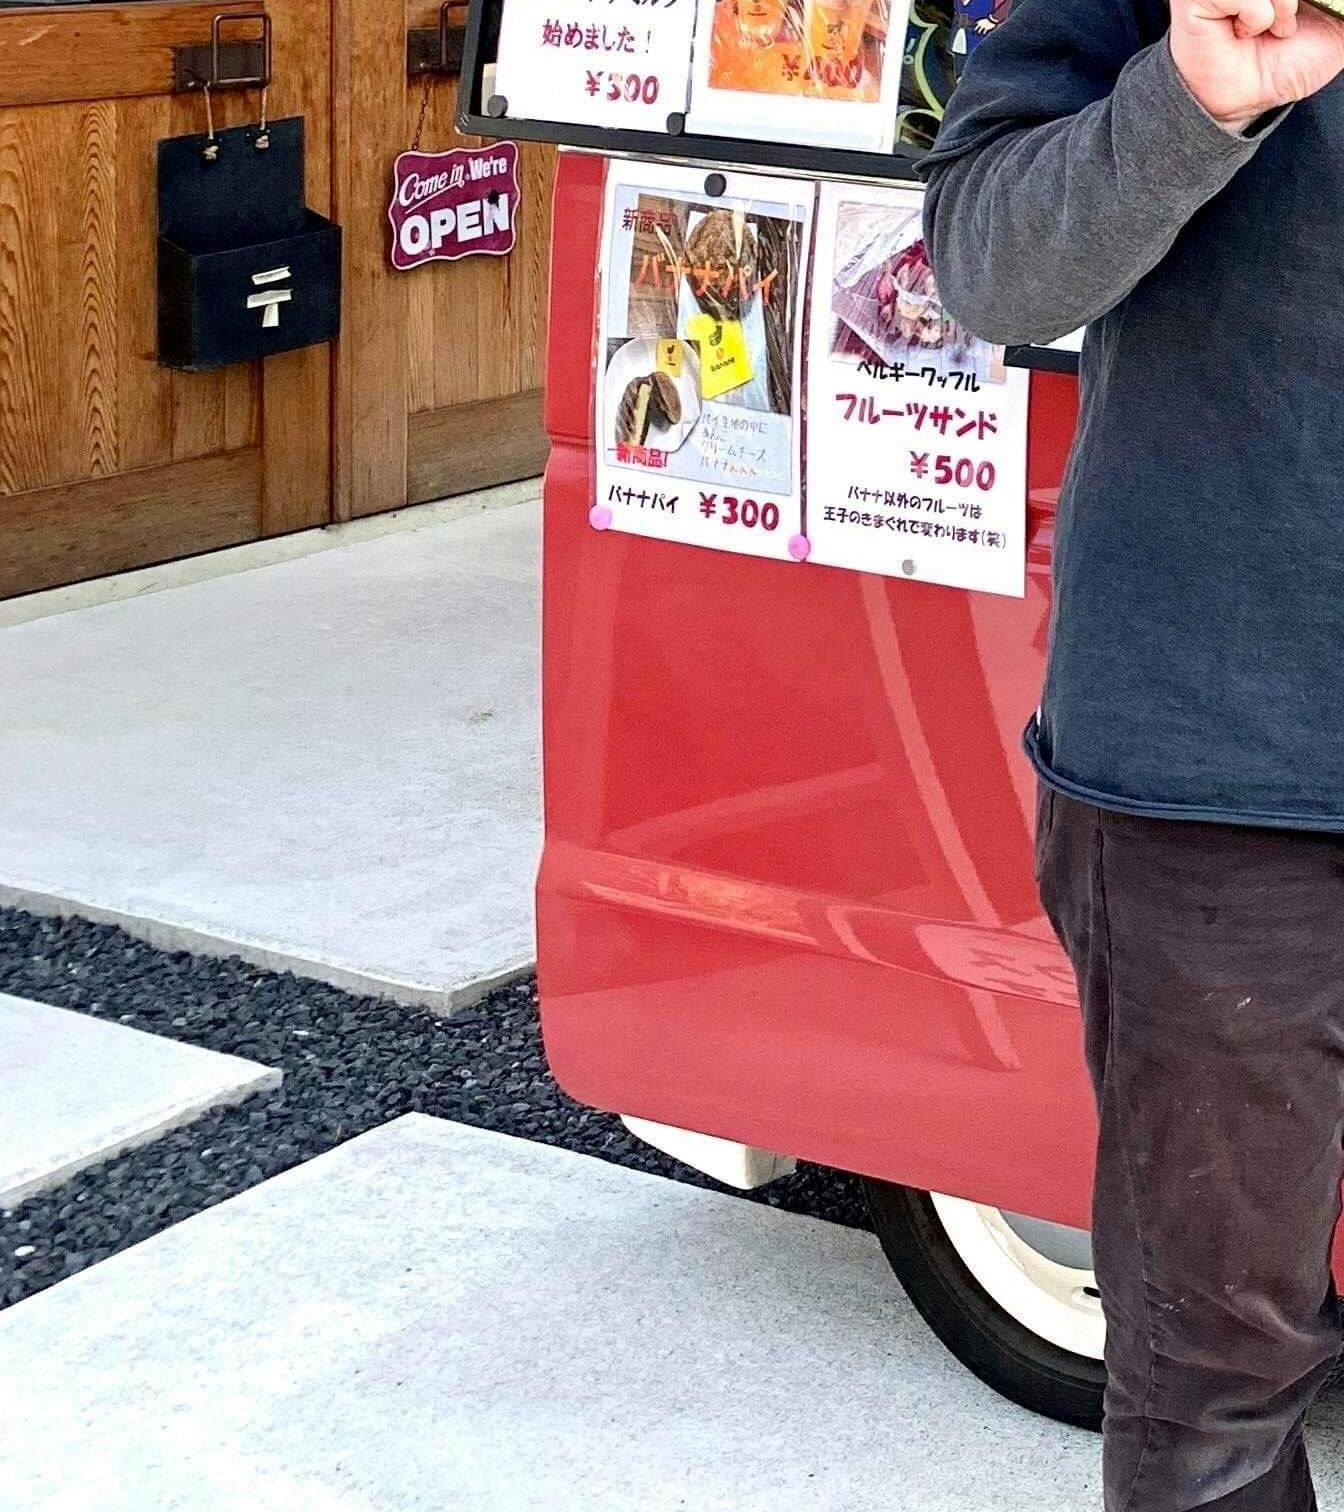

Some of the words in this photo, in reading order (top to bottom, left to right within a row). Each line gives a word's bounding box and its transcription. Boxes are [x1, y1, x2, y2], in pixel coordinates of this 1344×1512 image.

[542, 18, 652, 54] 始めました!
[399, 172, 448, 207] Come
[450, 163, 466, 185] in
[468, 156, 508, 181] We're
[400, 193, 510, 256] OPEN
[622, 207, 673, 234] 新商品
[857, 360, 981, 394] ベルギーワッフル
[835, 392, 998, 441] フルーツサンド
[910, 451, 997, 492] ¥500
[608, 484, 680, 515] バナナパイ
[698, 491, 781, 533] ¥300
[847, 485, 983, 519] バナナ以外のフルーツは
